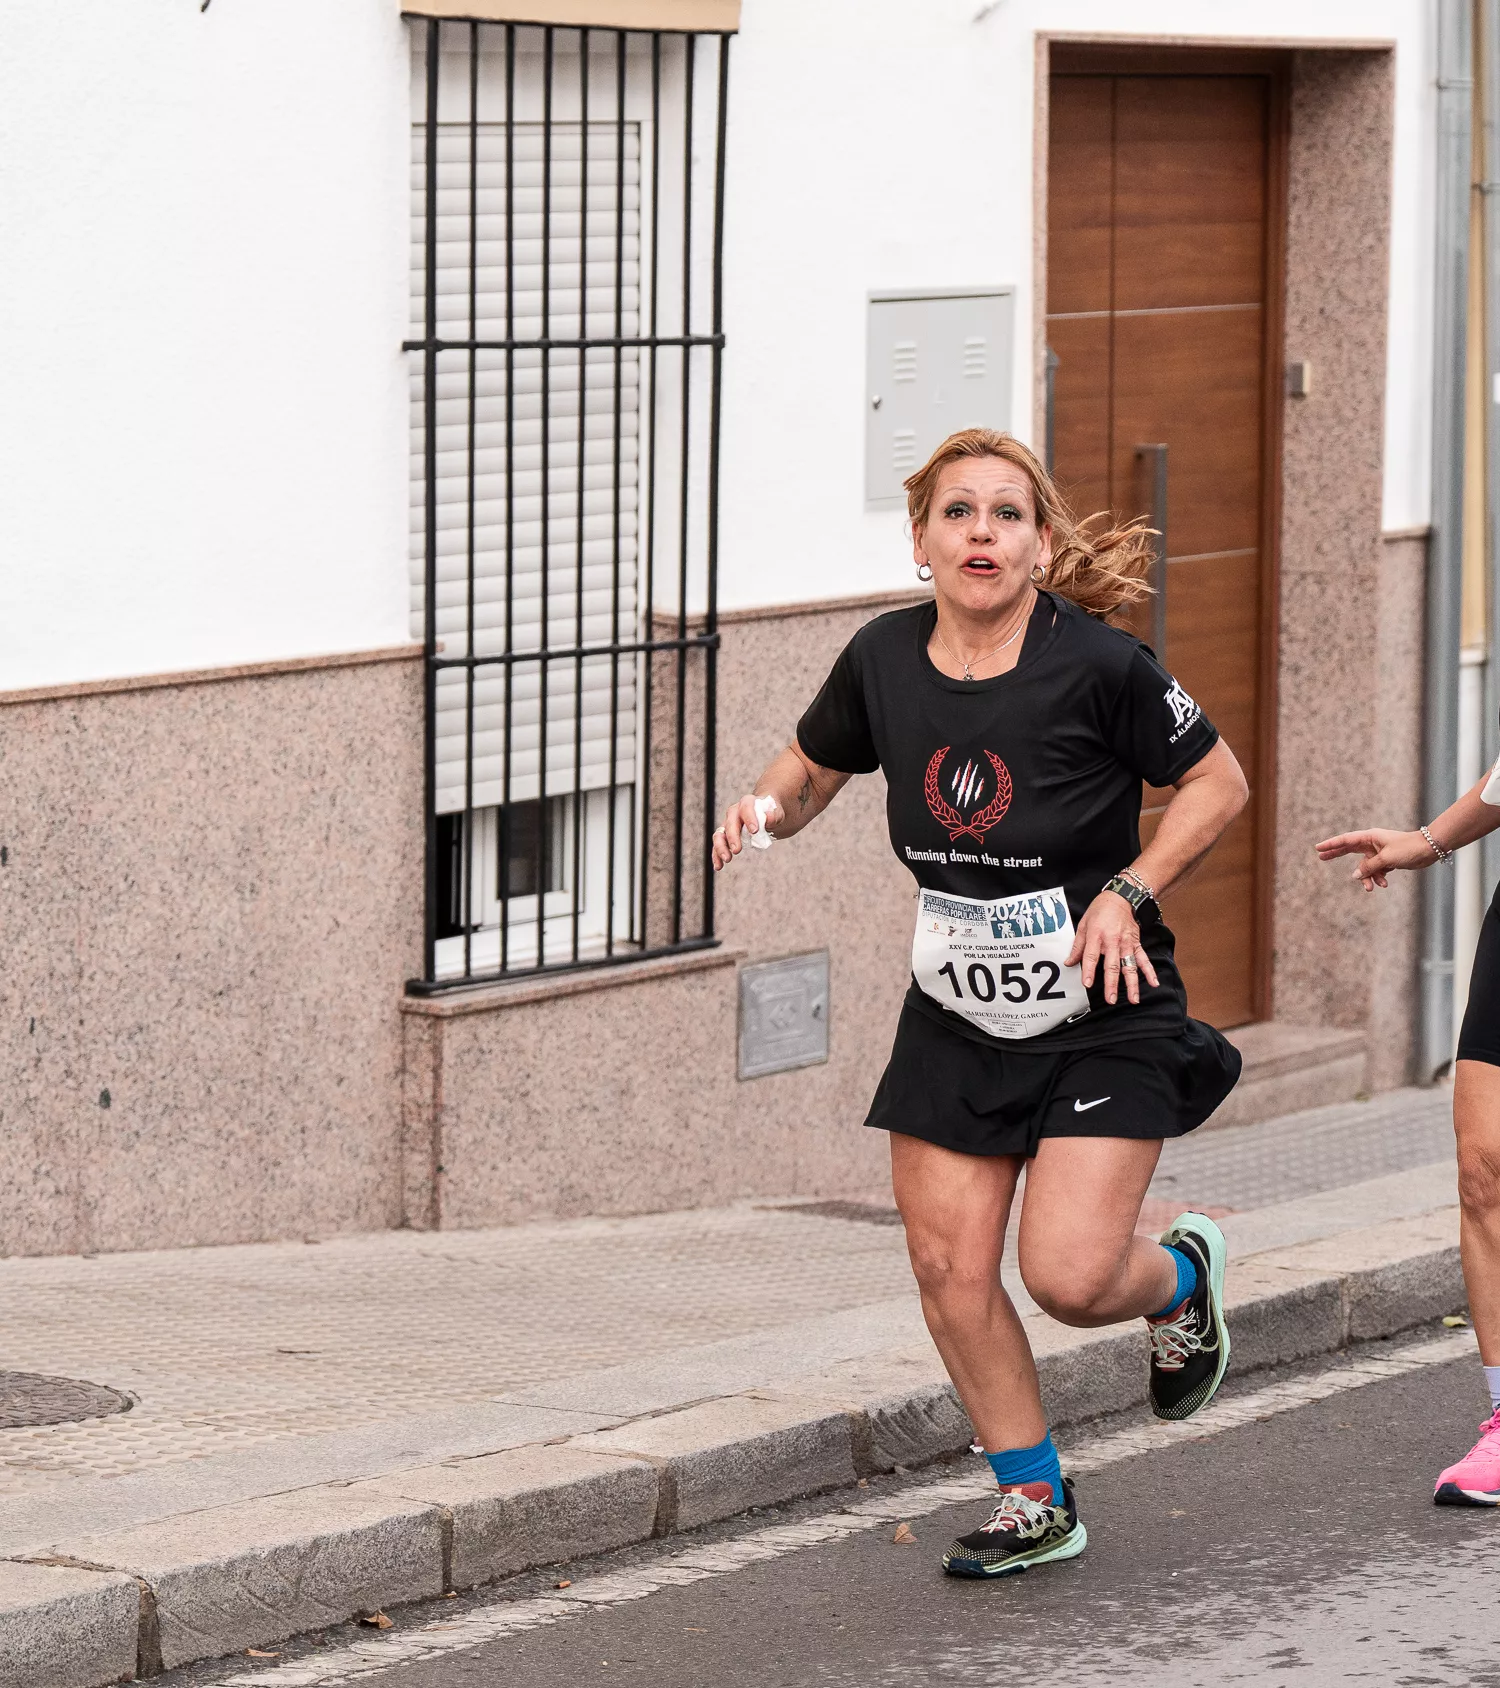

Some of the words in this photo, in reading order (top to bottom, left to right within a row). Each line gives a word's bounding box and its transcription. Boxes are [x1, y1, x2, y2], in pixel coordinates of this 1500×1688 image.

[1169, 734, 1178, 744] IX
[905, 846, 948, 864] Running
[950, 849, 980, 864] down
[981, 853, 1000, 866] the
[1004, 856, 1042, 868] street
[922, 903, 950, 916] CARRERAS
[950, 910, 986, 920] POPULARES
[946, 900, 976, 912] PROVINCIAL
[976, 906, 986, 914] DE
[987, 899, 1032, 921] 2024
[938, 960, 1066, 1003] 1052
